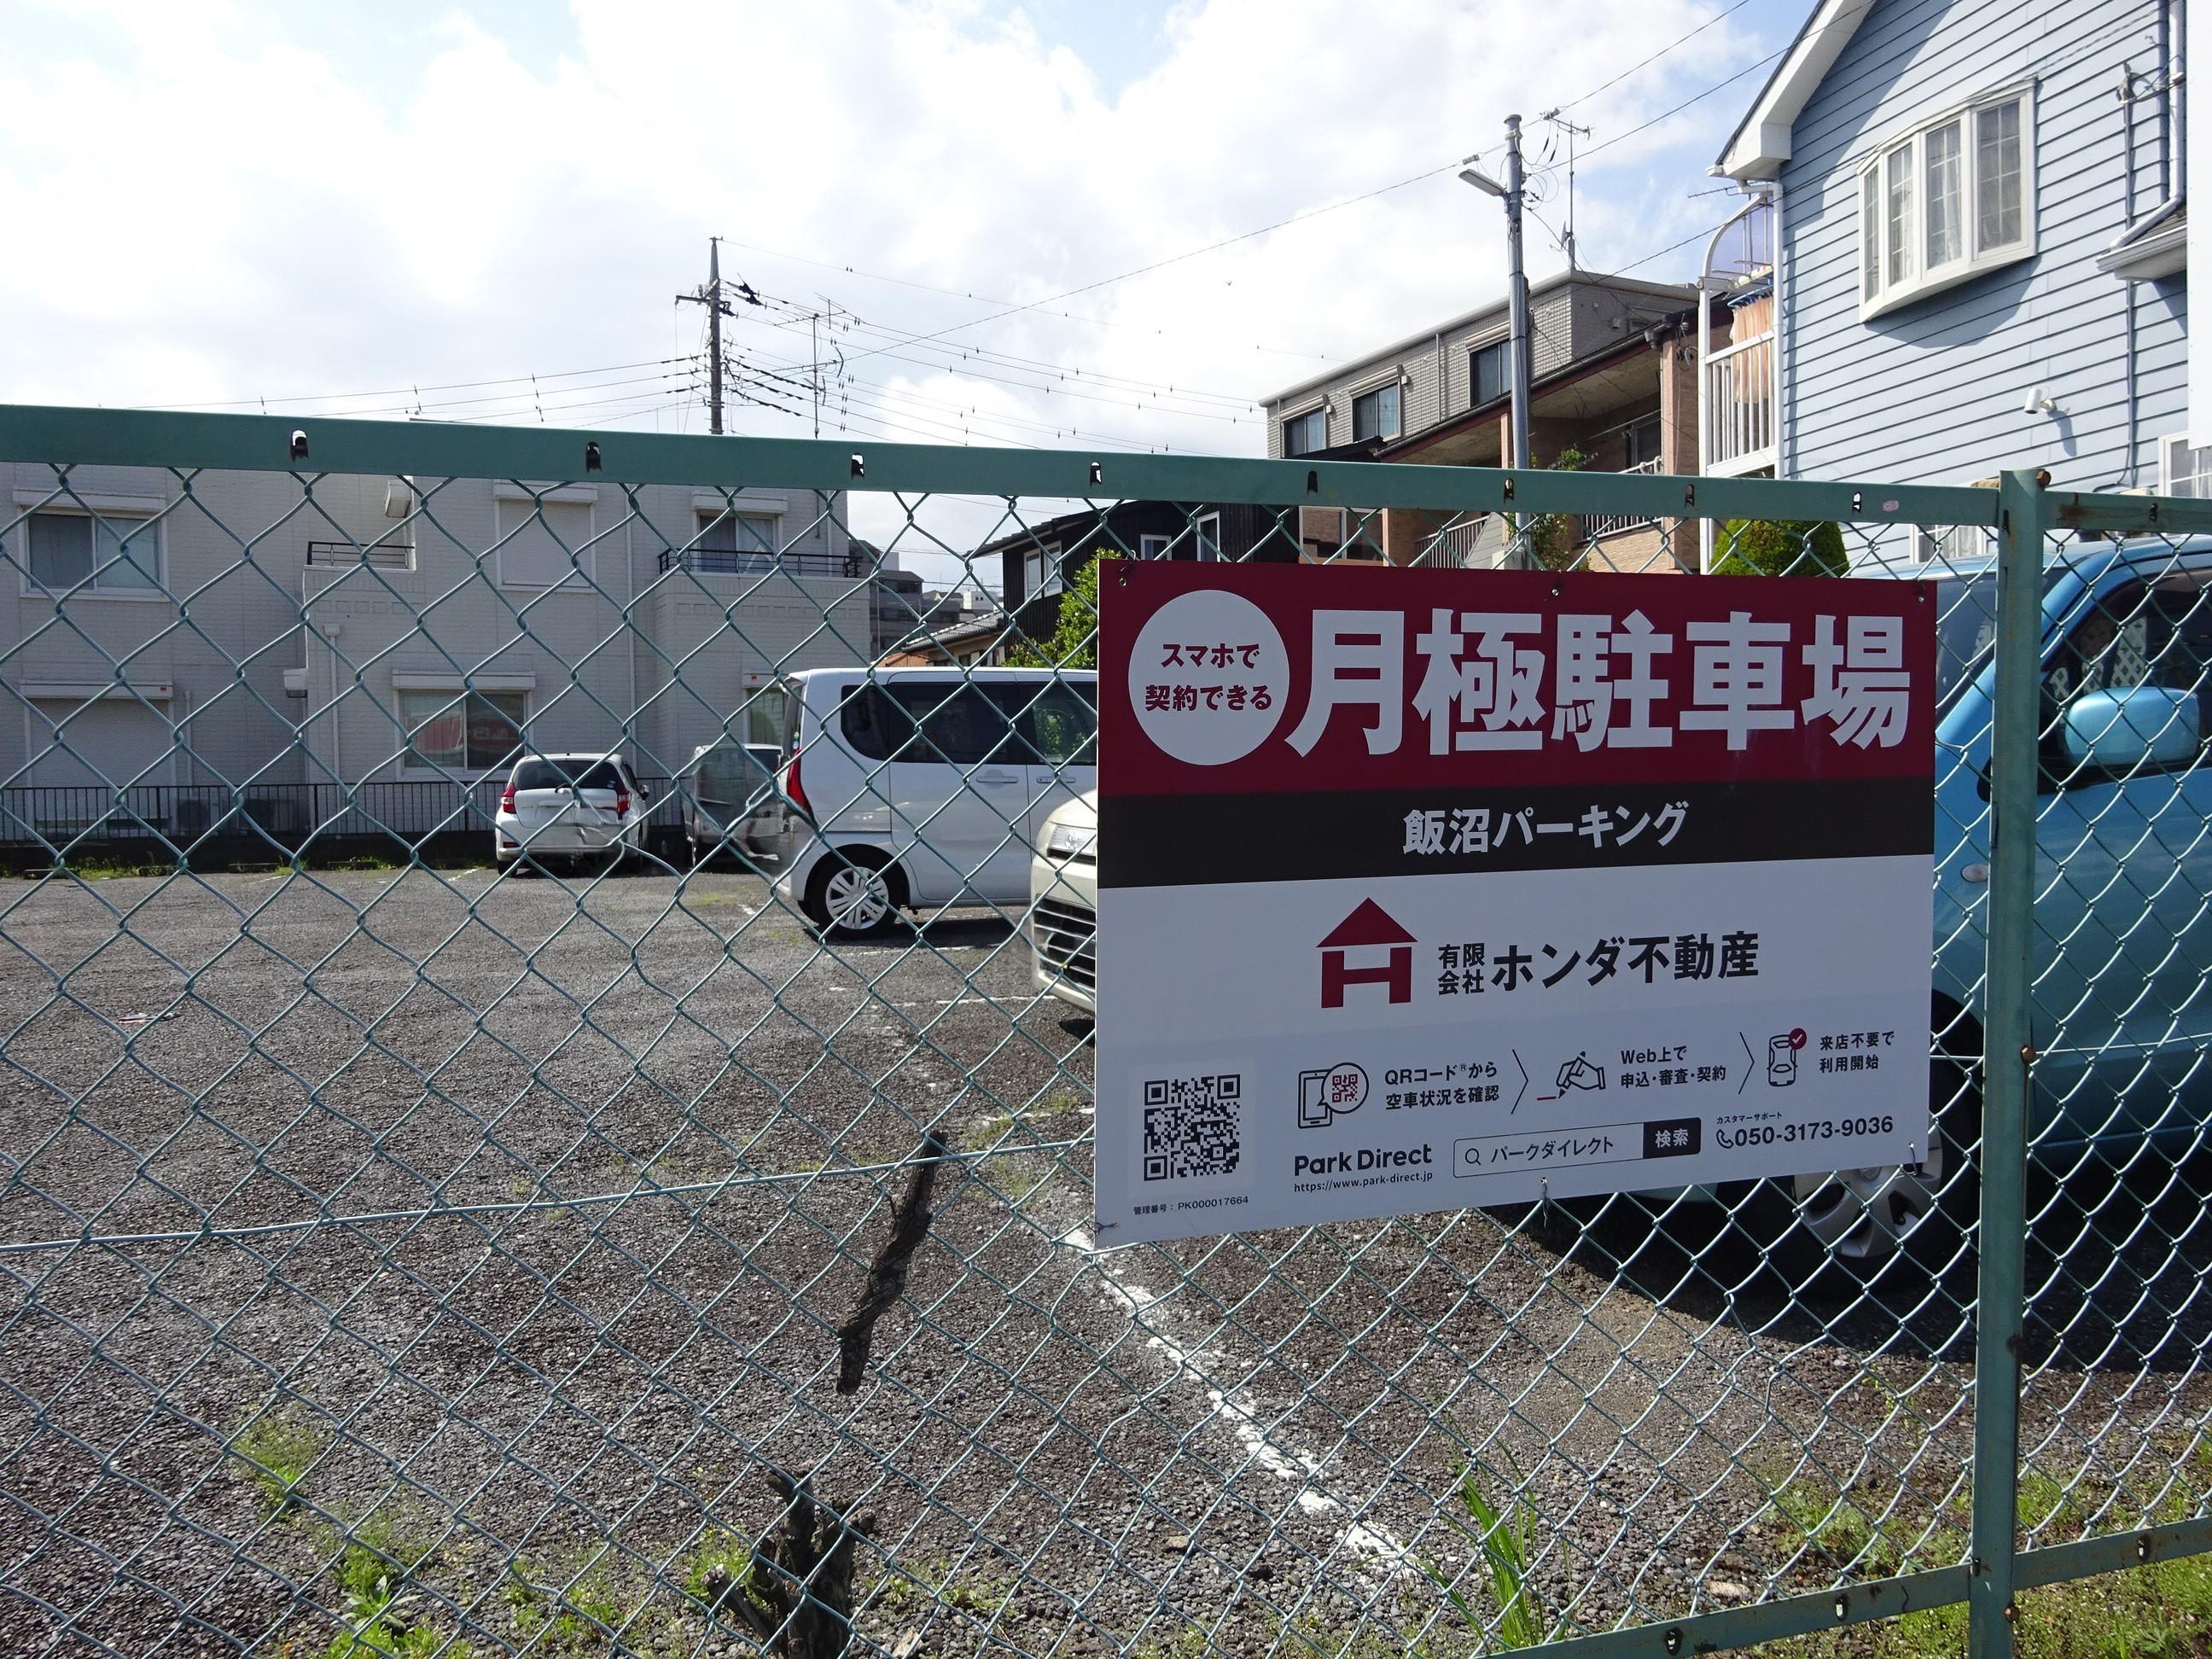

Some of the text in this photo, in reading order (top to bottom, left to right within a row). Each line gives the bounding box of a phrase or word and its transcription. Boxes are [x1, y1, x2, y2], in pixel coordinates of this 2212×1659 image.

[1160, 643, 1260, 670] スマホで
[1284, 608, 1911, 758] 月極駐車場
[1144, 684, 1273, 713] 契約できる
[1402, 800, 1690, 856] 飯沼パーキング
[1438, 942, 1486, 969] 有限
[1490, 930, 1759, 992] ホンダ不動産
[1437, 969, 1485, 996] 会社
[1819, 1030, 1895, 1051] 来店不要で
[1621, 1045, 1688, 1065] Web上で
[1819, 1053, 1880, 1074] 利用開始
[1385, 1085, 1500, 1110] 空車状況を確認
[1716, 1111, 1783, 1125] カスタマーサポート
[1734, 1115, 1895, 1147] 050-3173-9036
[1491, 1136, 1614, 1161] パークダイレクト
[1655, 1127, 1690, 1149] 検索
[1294, 1144, 1433, 1177] Park Direct
[1294, 1170, 1433, 1193] https://www.park-direct.jp
[1177, 1195, 1249, 1210] PK000017664
